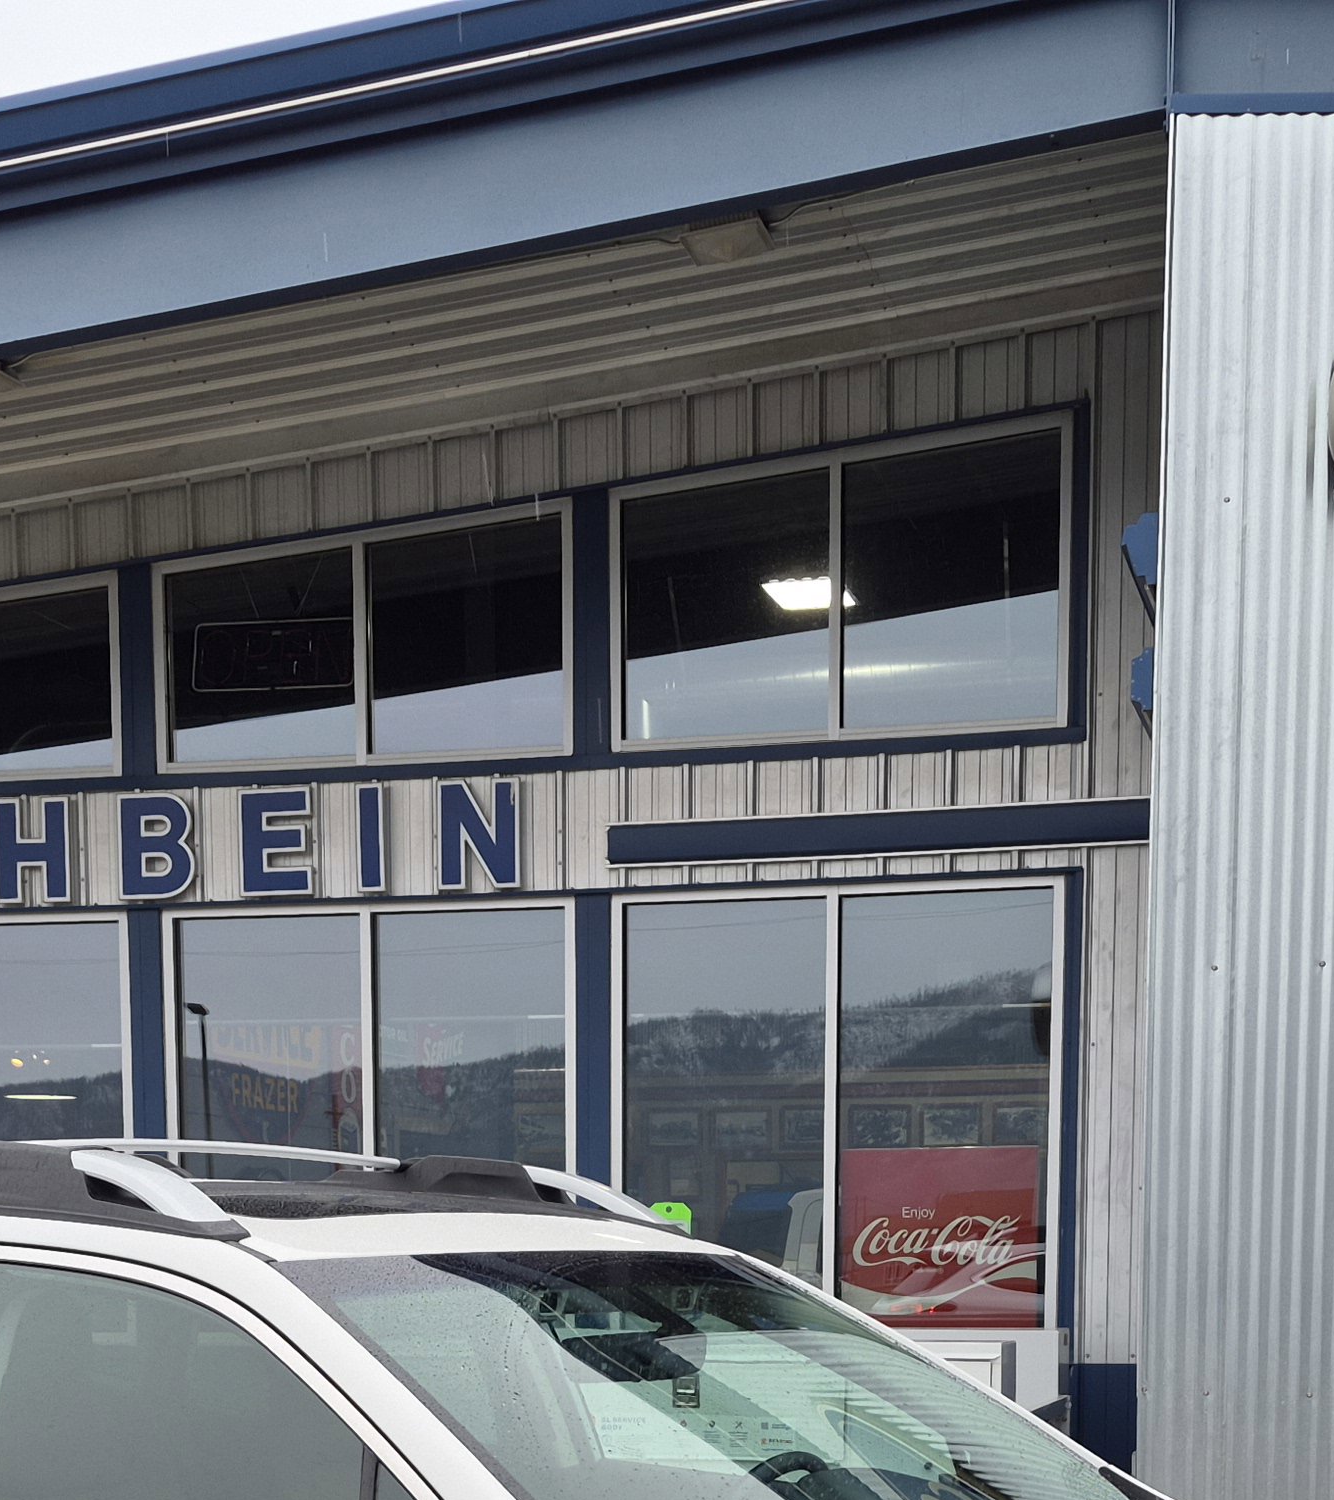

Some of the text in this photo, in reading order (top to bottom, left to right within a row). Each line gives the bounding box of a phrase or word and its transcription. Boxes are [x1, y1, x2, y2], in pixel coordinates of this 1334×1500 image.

[422, 1031, 465, 1068] SERVICE
[231, 1072, 299, 1113] FRAZER
[901, 1206, 936, 1220] Enjoy
